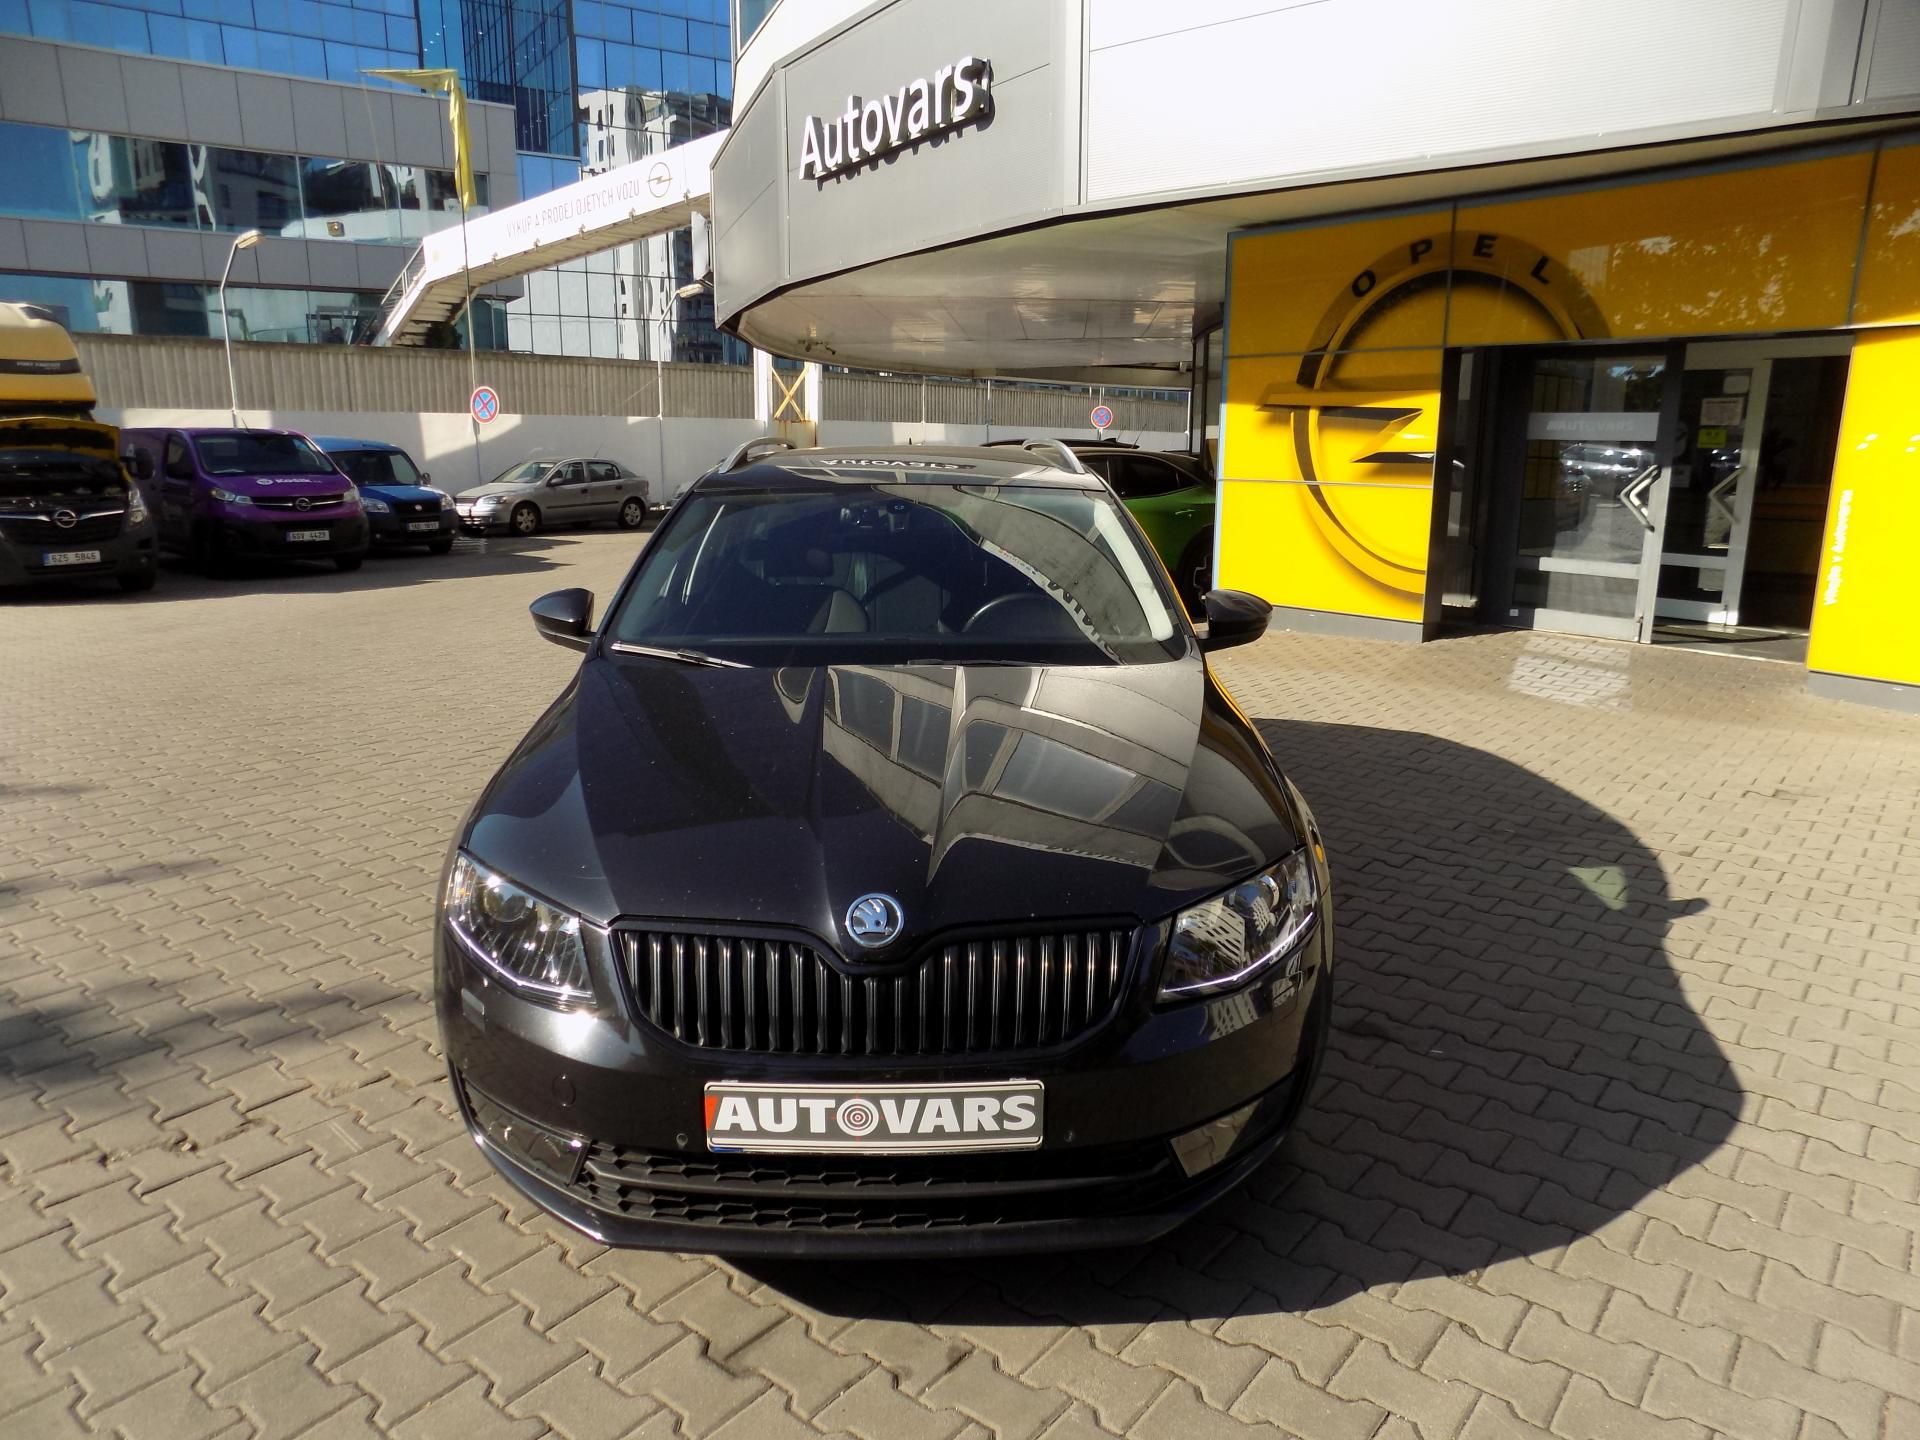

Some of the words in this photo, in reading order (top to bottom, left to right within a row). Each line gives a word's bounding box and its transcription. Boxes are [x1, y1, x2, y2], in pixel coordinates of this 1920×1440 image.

[799, 56, 990, 181] Autovars
[541, 202, 574, 226] PRODEJ
[1352, 234, 1550, 298] OPEL
[714, 1095, 1037, 1137] AUTOVARS
